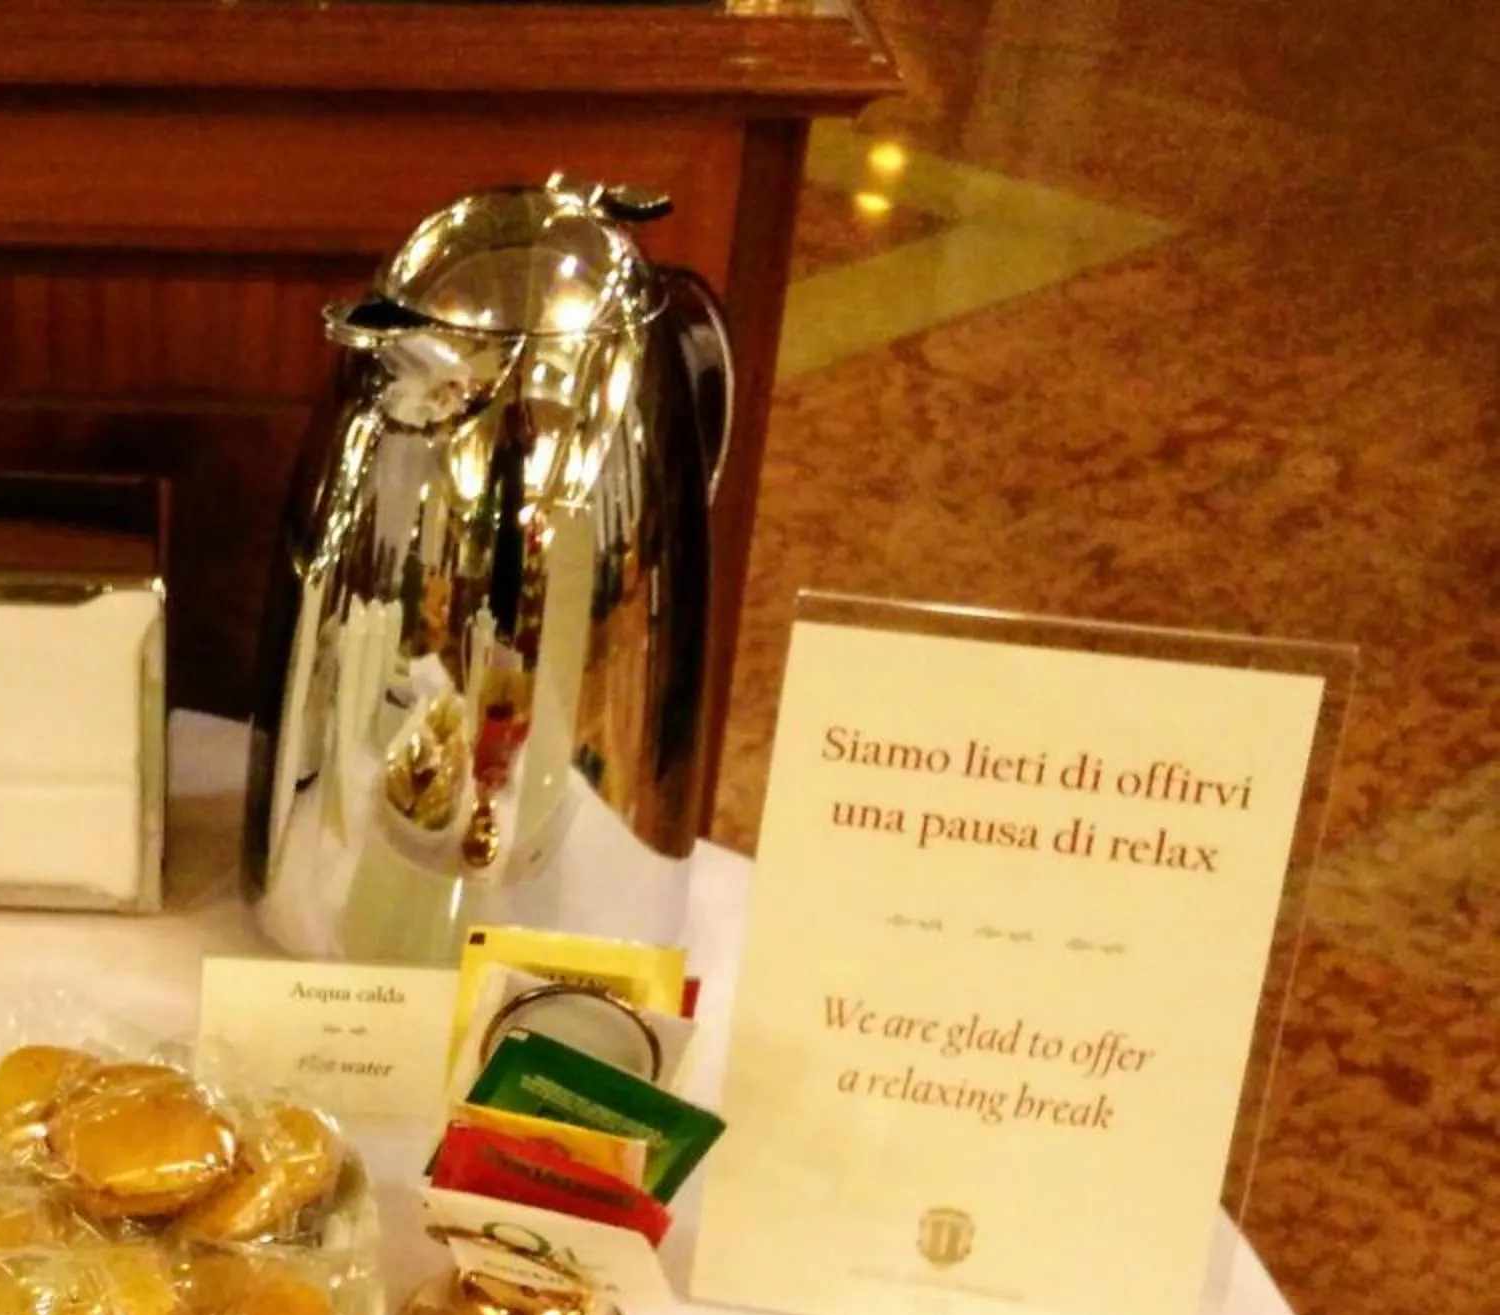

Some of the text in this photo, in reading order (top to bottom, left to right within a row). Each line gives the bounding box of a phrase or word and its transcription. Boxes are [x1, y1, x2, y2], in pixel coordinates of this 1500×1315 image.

[822, 727, 1252, 811] Siamo lieti di offirvi
[831, 800, 1219, 873] una pausa di relax
[290, 981, 405, 1003] Acqua calda
[340, 1059, 394, 1077] water
[823, 996, 1156, 1078] We are glad to offer
[837, 1067, 1114, 1130] a relaxing break
